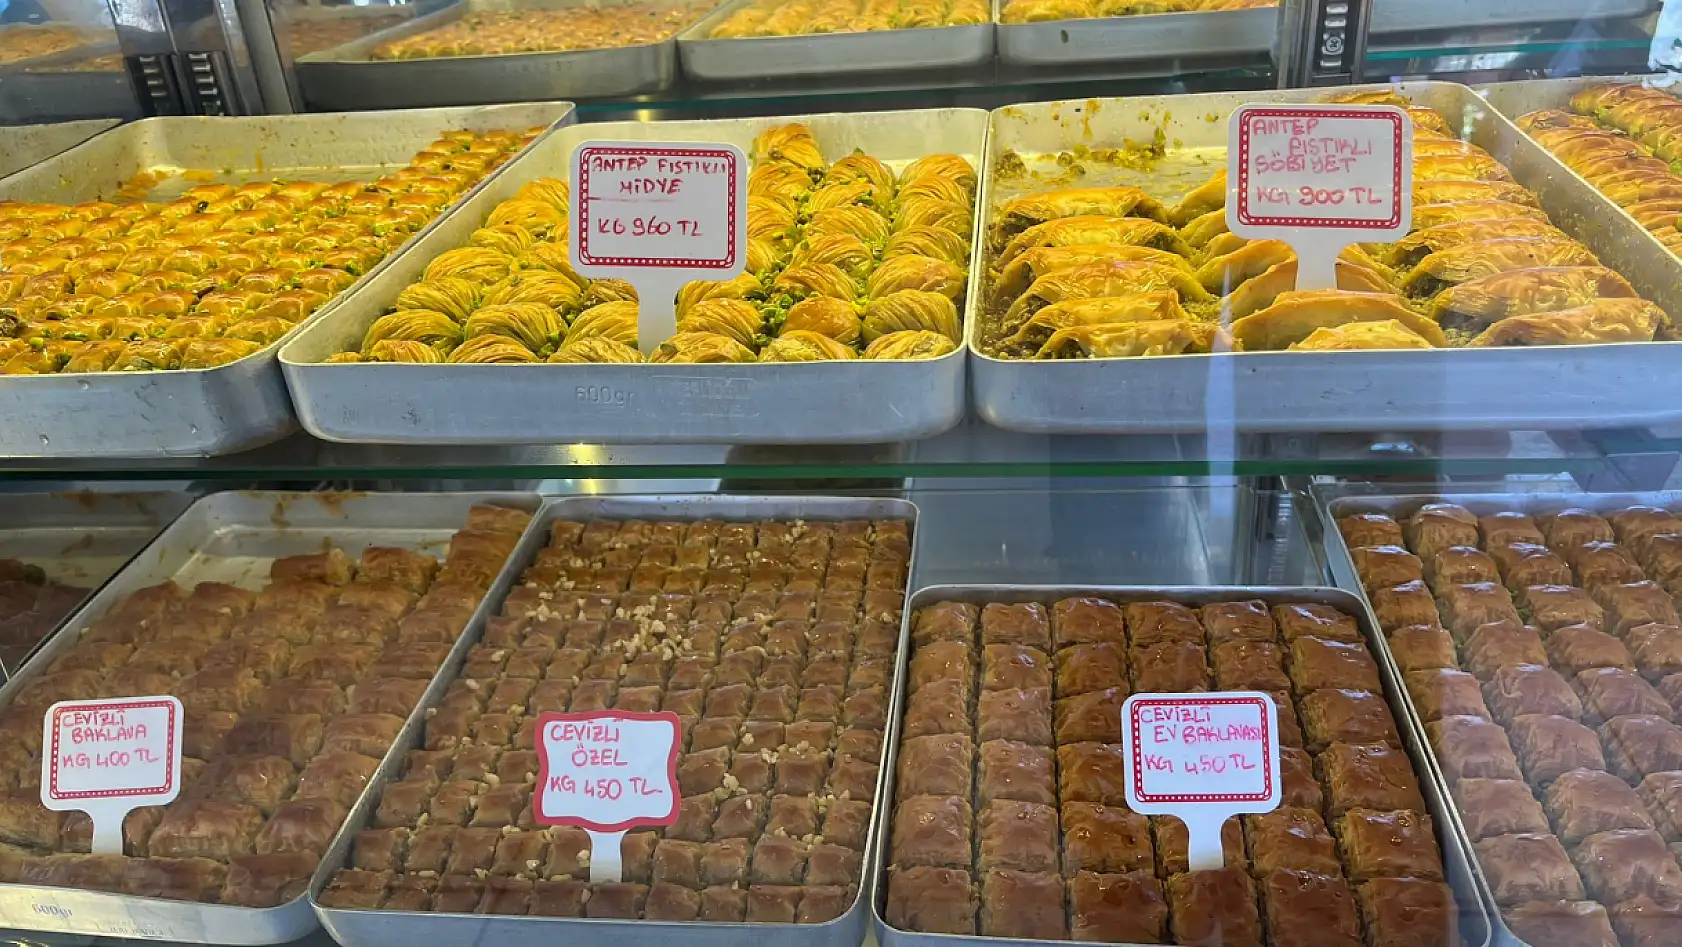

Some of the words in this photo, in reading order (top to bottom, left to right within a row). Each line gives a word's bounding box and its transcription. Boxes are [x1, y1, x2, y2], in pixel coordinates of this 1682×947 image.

[1253, 119, 1319, 136] ANTEP
[592, 156, 647, 172] ANTEP
[1256, 186, 1290, 205] KG
[1298, 185, 1345, 206] 900
[1349, 187, 1382, 204] TL
[598, 217, 626, 234] KG
[632, 215, 671, 236] 960
[677, 220, 703, 236] TL
[575, 386, 635, 408] 600gr
[71, 724, 148, 744] BAKLAVA
[1154, 724, 1177, 743] EV
[62, 753, 91, 769] KG
[96, 751, 130, 769] 400
[134, 748, 160, 762] TL
[572, 743, 628, 767] ÖZEL
[1144, 754, 1173, 773] KG
[1184, 755, 1225, 775] 450
[1229, 753, 1256, 770] TL
[550, 775, 576, 793] KG
[584, 778, 622, 800] 450
[629, 776, 663, 795] TL
